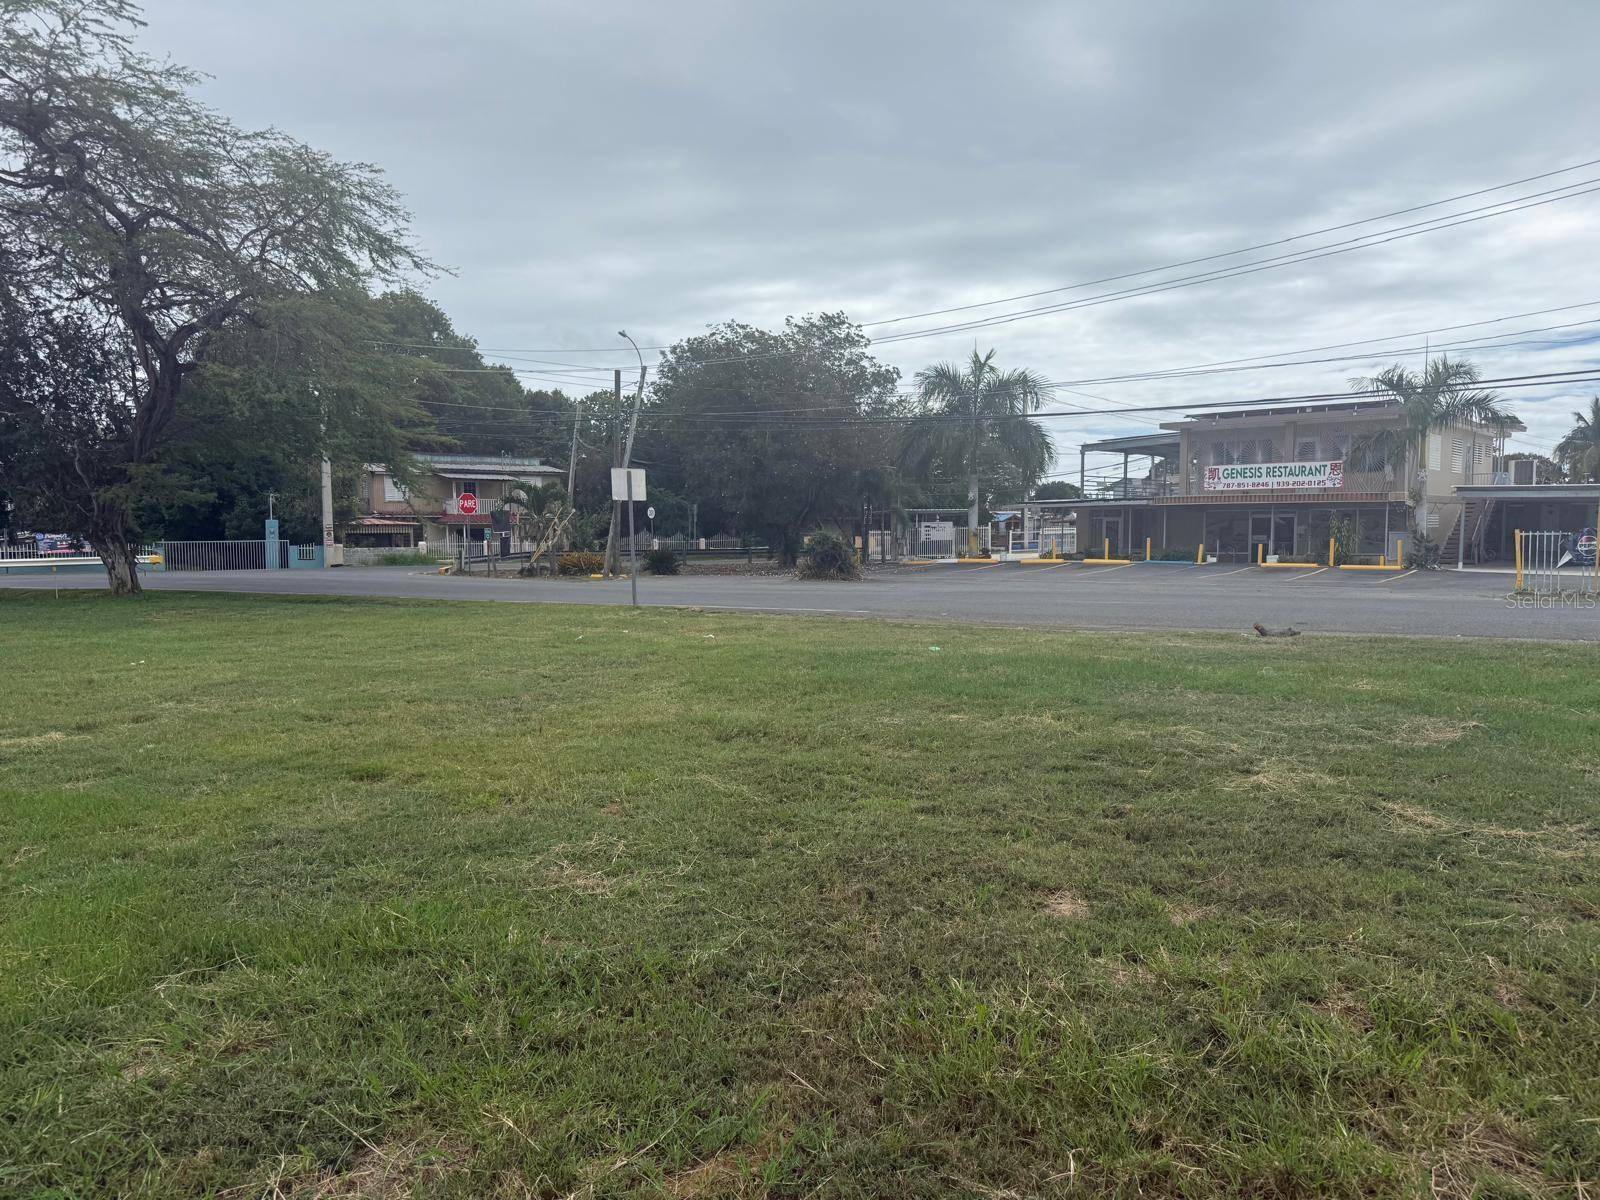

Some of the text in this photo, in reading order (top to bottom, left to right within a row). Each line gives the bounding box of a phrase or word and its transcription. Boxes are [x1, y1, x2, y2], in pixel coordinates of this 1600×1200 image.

[1222, 467, 1263, 479] GENESIS
[1265, 464, 1327, 478] RESTAURANT
[459, 499, 476, 508] PARE
